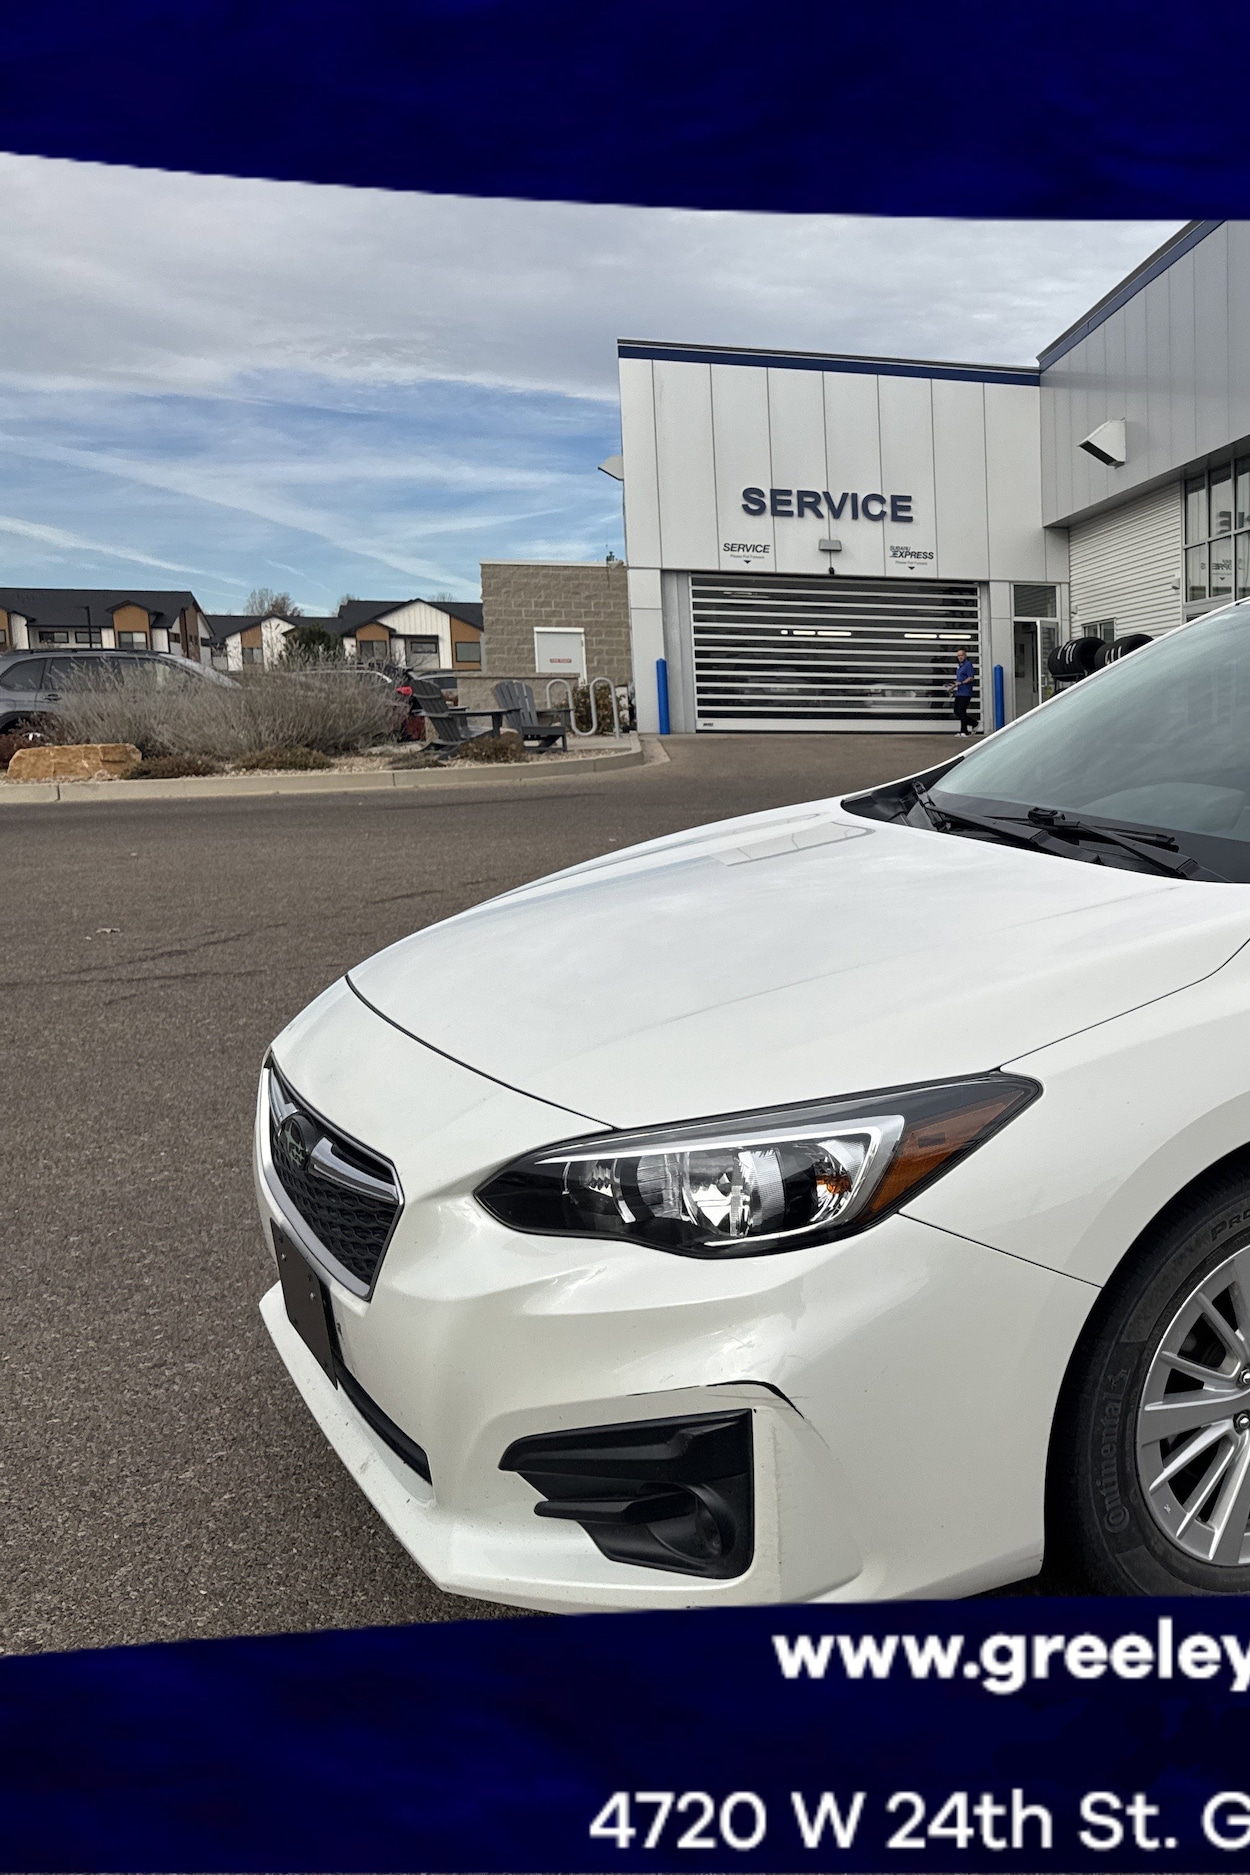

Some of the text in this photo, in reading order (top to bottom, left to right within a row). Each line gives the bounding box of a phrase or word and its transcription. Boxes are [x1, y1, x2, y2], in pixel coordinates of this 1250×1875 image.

[742, 487, 913, 523] SERVICE
[723, 542, 771, 554] SERVICE
[889, 550, 934, 560] EXPRESS
[1097, 1391, 1130, 1533] Continental
